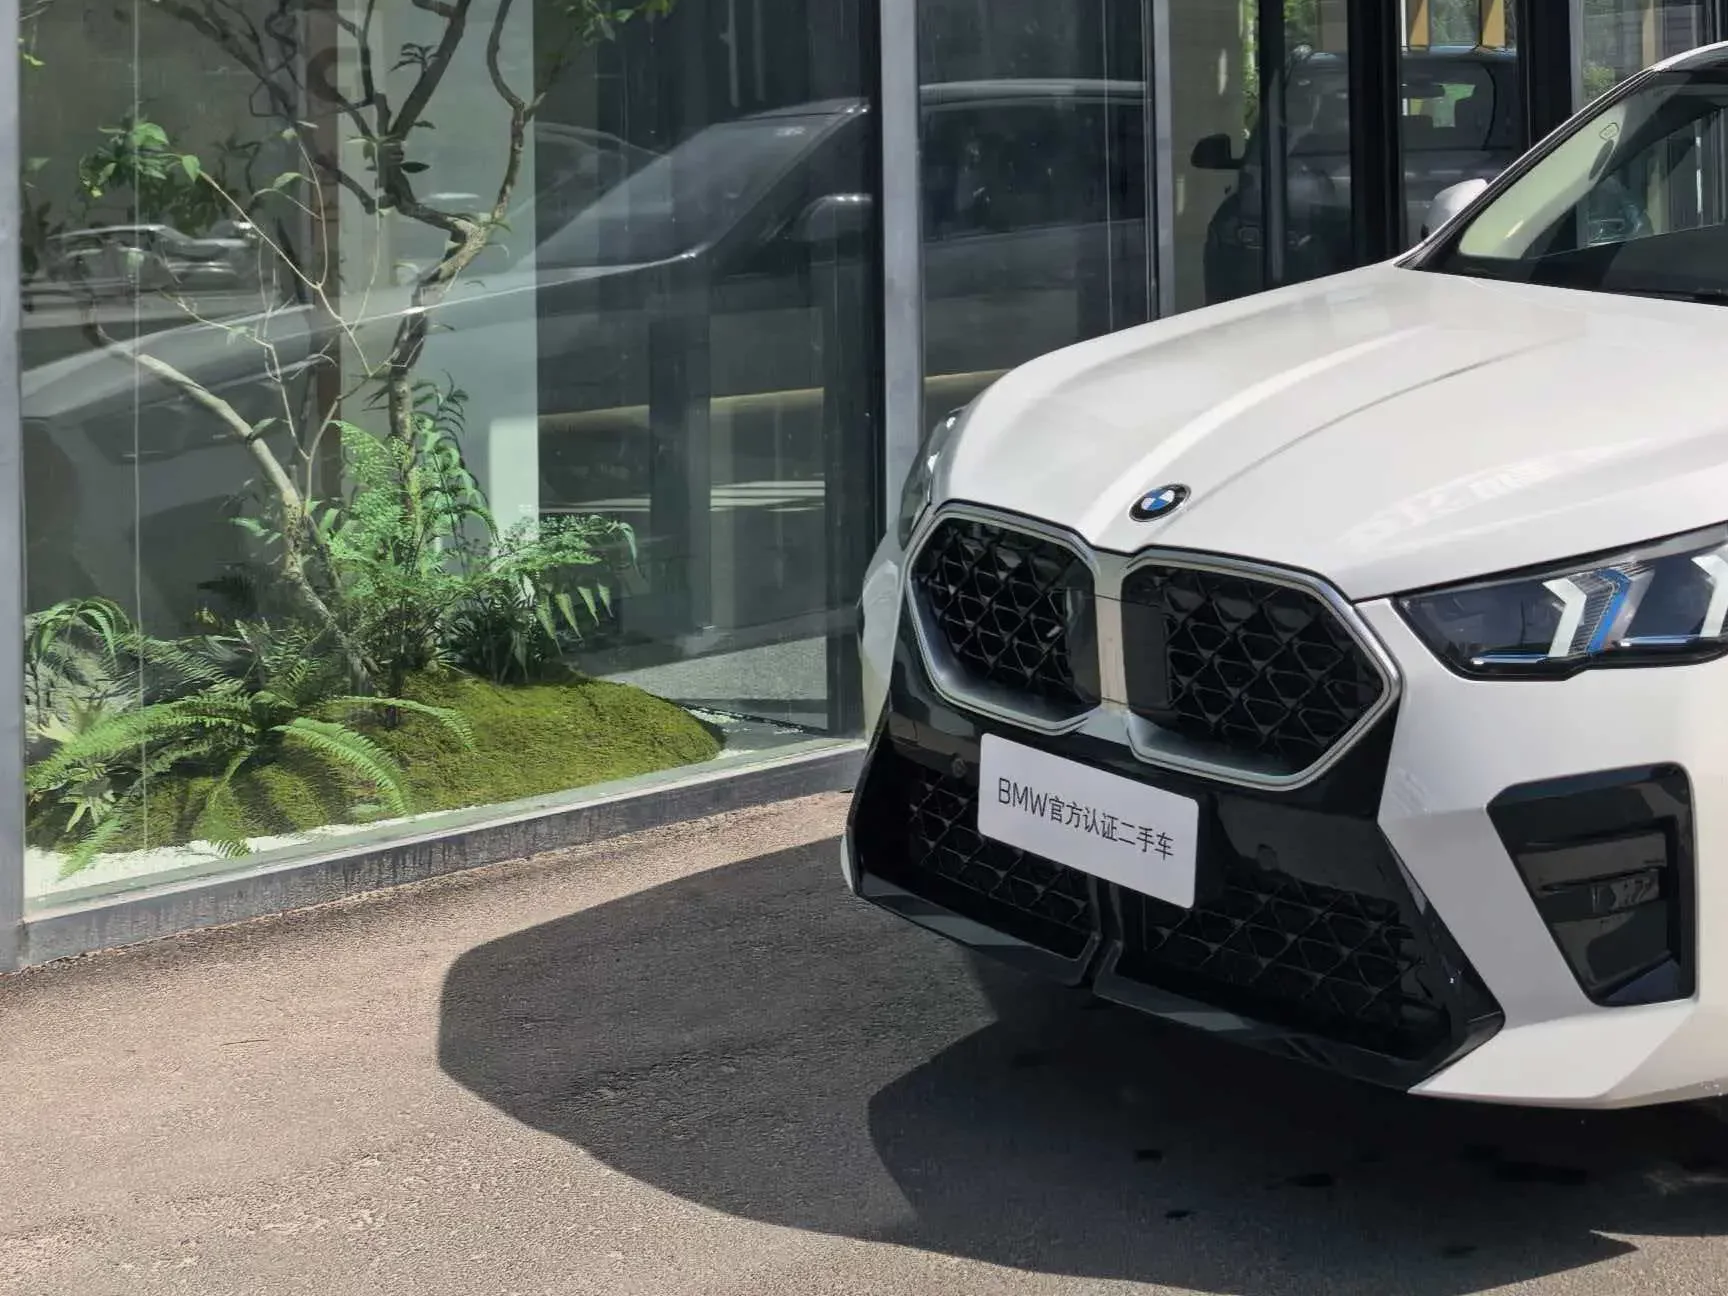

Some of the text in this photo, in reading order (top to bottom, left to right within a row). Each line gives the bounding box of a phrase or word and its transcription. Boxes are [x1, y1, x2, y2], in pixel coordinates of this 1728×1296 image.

[998, 777, 1174, 860] BMW官方认证二手车
